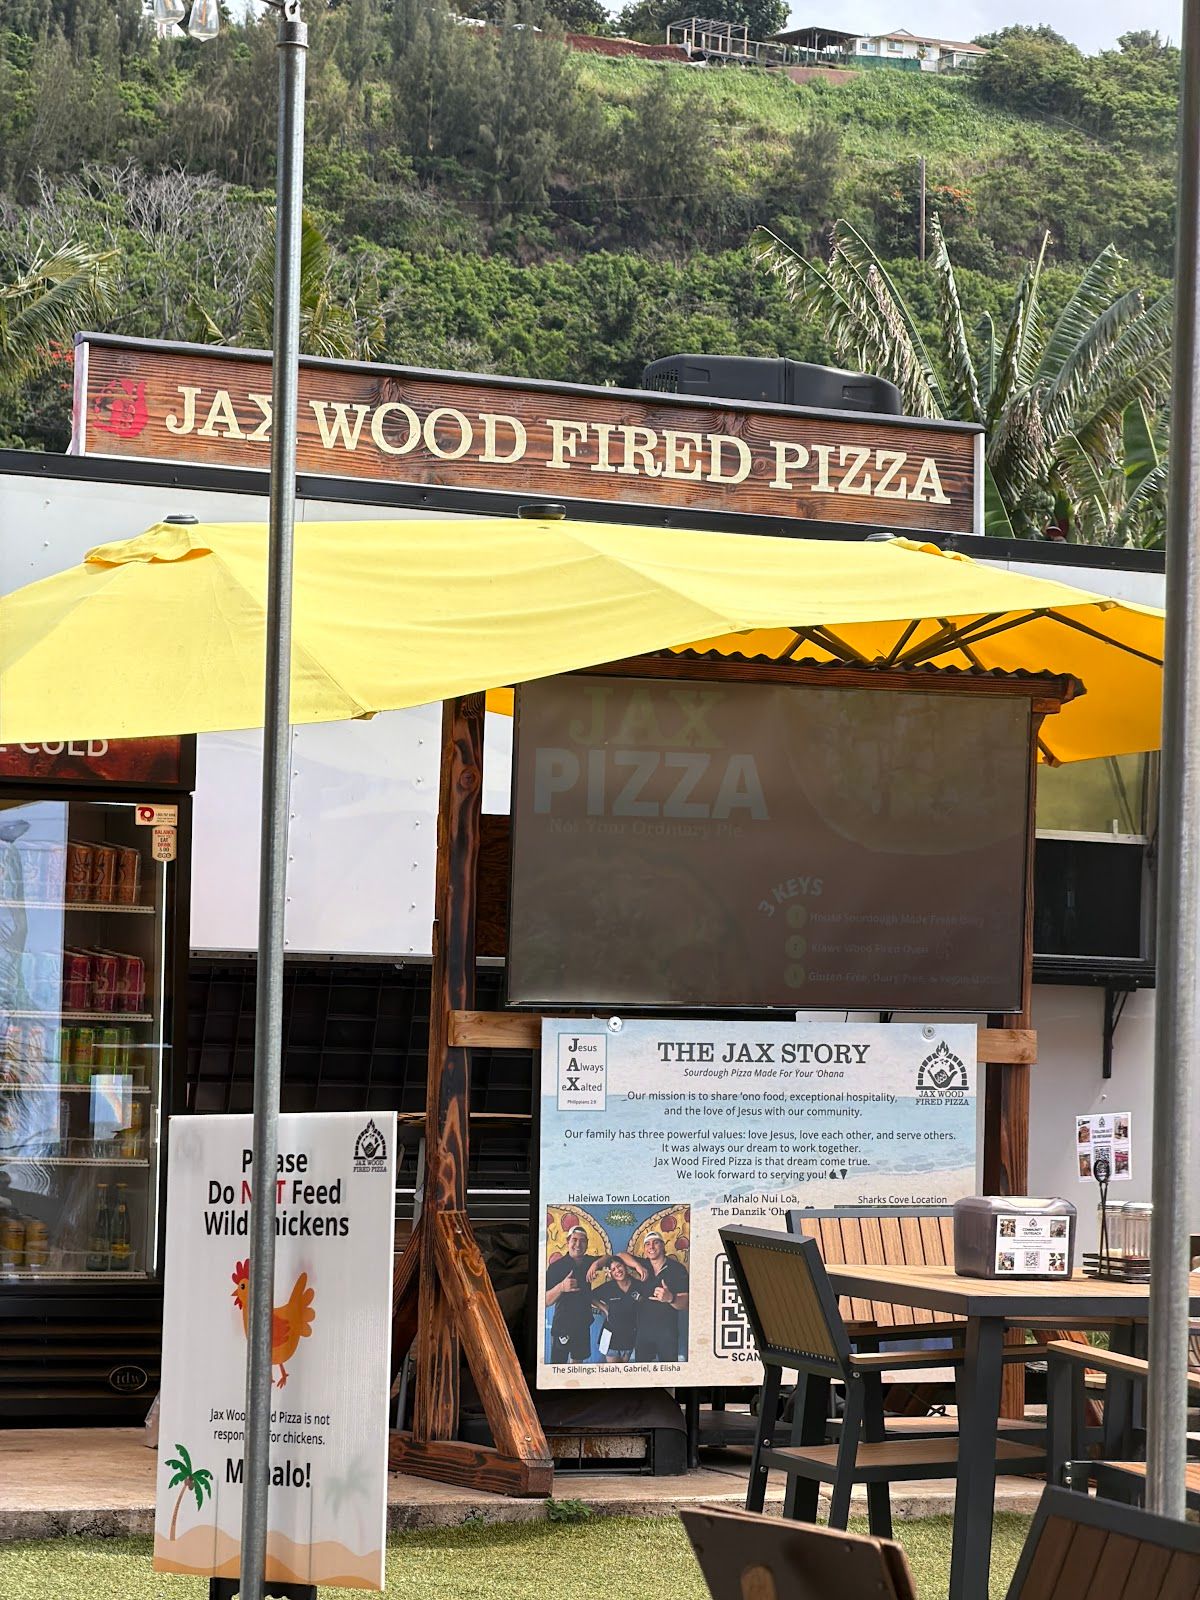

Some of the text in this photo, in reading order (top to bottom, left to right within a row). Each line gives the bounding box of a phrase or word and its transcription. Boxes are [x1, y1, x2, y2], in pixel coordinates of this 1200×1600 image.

[309, 400, 527, 464] WOOD
[546, 419, 752, 485] FIRED
[769, 441, 951, 504] PIZZA
[569, 686, 728, 748] JAX
[534, 746, 770, 820] PIZZA
[771, 876, 823, 904] KEYS
[568, 1038, 597, 1052] Jesus
[658, 1043, 870, 1064] THE JAX STORY
[567, 1058, 603, 1072] Always
[684, 1069, 728, 1079] Sourdough
[732, 1069, 752, 1077] Pizza
[754, 1069, 777, 1077] Made
[779, 1070, 792, 1078] For
[795, 1070, 813, 1078] Your
[562, 1077, 602, 1091] eXalted
[628, 1092, 645, 1100] Our
[649, 1092, 686, 1100] mission
[688, 1092, 696, 1100] is
[699, 1092, 708, 1100] to
[711, 1092, 737, 1100] share
[764, 1092, 786, 1103] food,
[790, 1092, 843, 1103] exceptional
[846, 1093, 897, 1103] hospitality,
[938, 1090, 964, 1098] WOOD
[664, 1106, 862, 1118] and the love of Jesus with our community.
[565, 1130, 583, 1138] Our
[586, 1130, 616, 1140] family
[619, 1130, 635, 1138] has
[639, 1130, 664, 1138] three
[668, 1130, 710, 1140] powerful
[713, 1130, 745, 1138] values:
[748, 1131, 767, 1139] love
[770, 1131, 796, 1141] Jesus,
[800, 1131, 818, 1139] love
[822, 1131, 843, 1139] each
[846, 1131, 874, 1141] other,
[876, 1131, 893, 1139] and
[924, 1131, 956, 1139] others.
[662, 1144, 668, 1152] It
[693, 1144, 724, 1154] always
[746, 1144, 777, 1152] dream
[780, 1144, 790, 1152] to
[793, 1144, 816, 1152] work
[818, 1144, 861, 1154] together.
[242, 1149, 308, 1173] Pase
[654, 1157, 668, 1168] Jax
[672, 1157, 698, 1166] Wood
[702, 1157, 725, 1166] Fired
[729, 1157, 752, 1166] Pizza
[755, 1157, 762, 1166] is
[765, 1157, 784, 1166] that
[787, 1157, 817, 1166] dream
[848, 1157, 870, 1166] true.
[677, 1171, 827, 1181] We look forward to serving you!
[208, 1178, 341, 1205] Do NT Feed
[568, 1194, 670, 1202] Haleiwa Town Location
[724, 1195, 758, 1203] Mahalo
[762, 1195, 778, 1203] Nui
[858, 1196, 947, 1204] Sharks Cove Location
[204, 1210, 349, 1236] Wild ickens
[568, 1366, 596, 1374] Siblings:
[624, 1365, 650, 1374] Gabriel,
[210, 1408, 224, 1422] Jax
[226, 1409, 246, 1421] Woo
[279, 1411, 302, 1424] Pizza
[304, 1412, 312, 1425] is
[314, 1413, 330, 1425] not
[213, 1430, 245, 1443] respon
[283, 1431, 325, 1445] chickens.
[226, 1458, 311, 1488] Malo!
